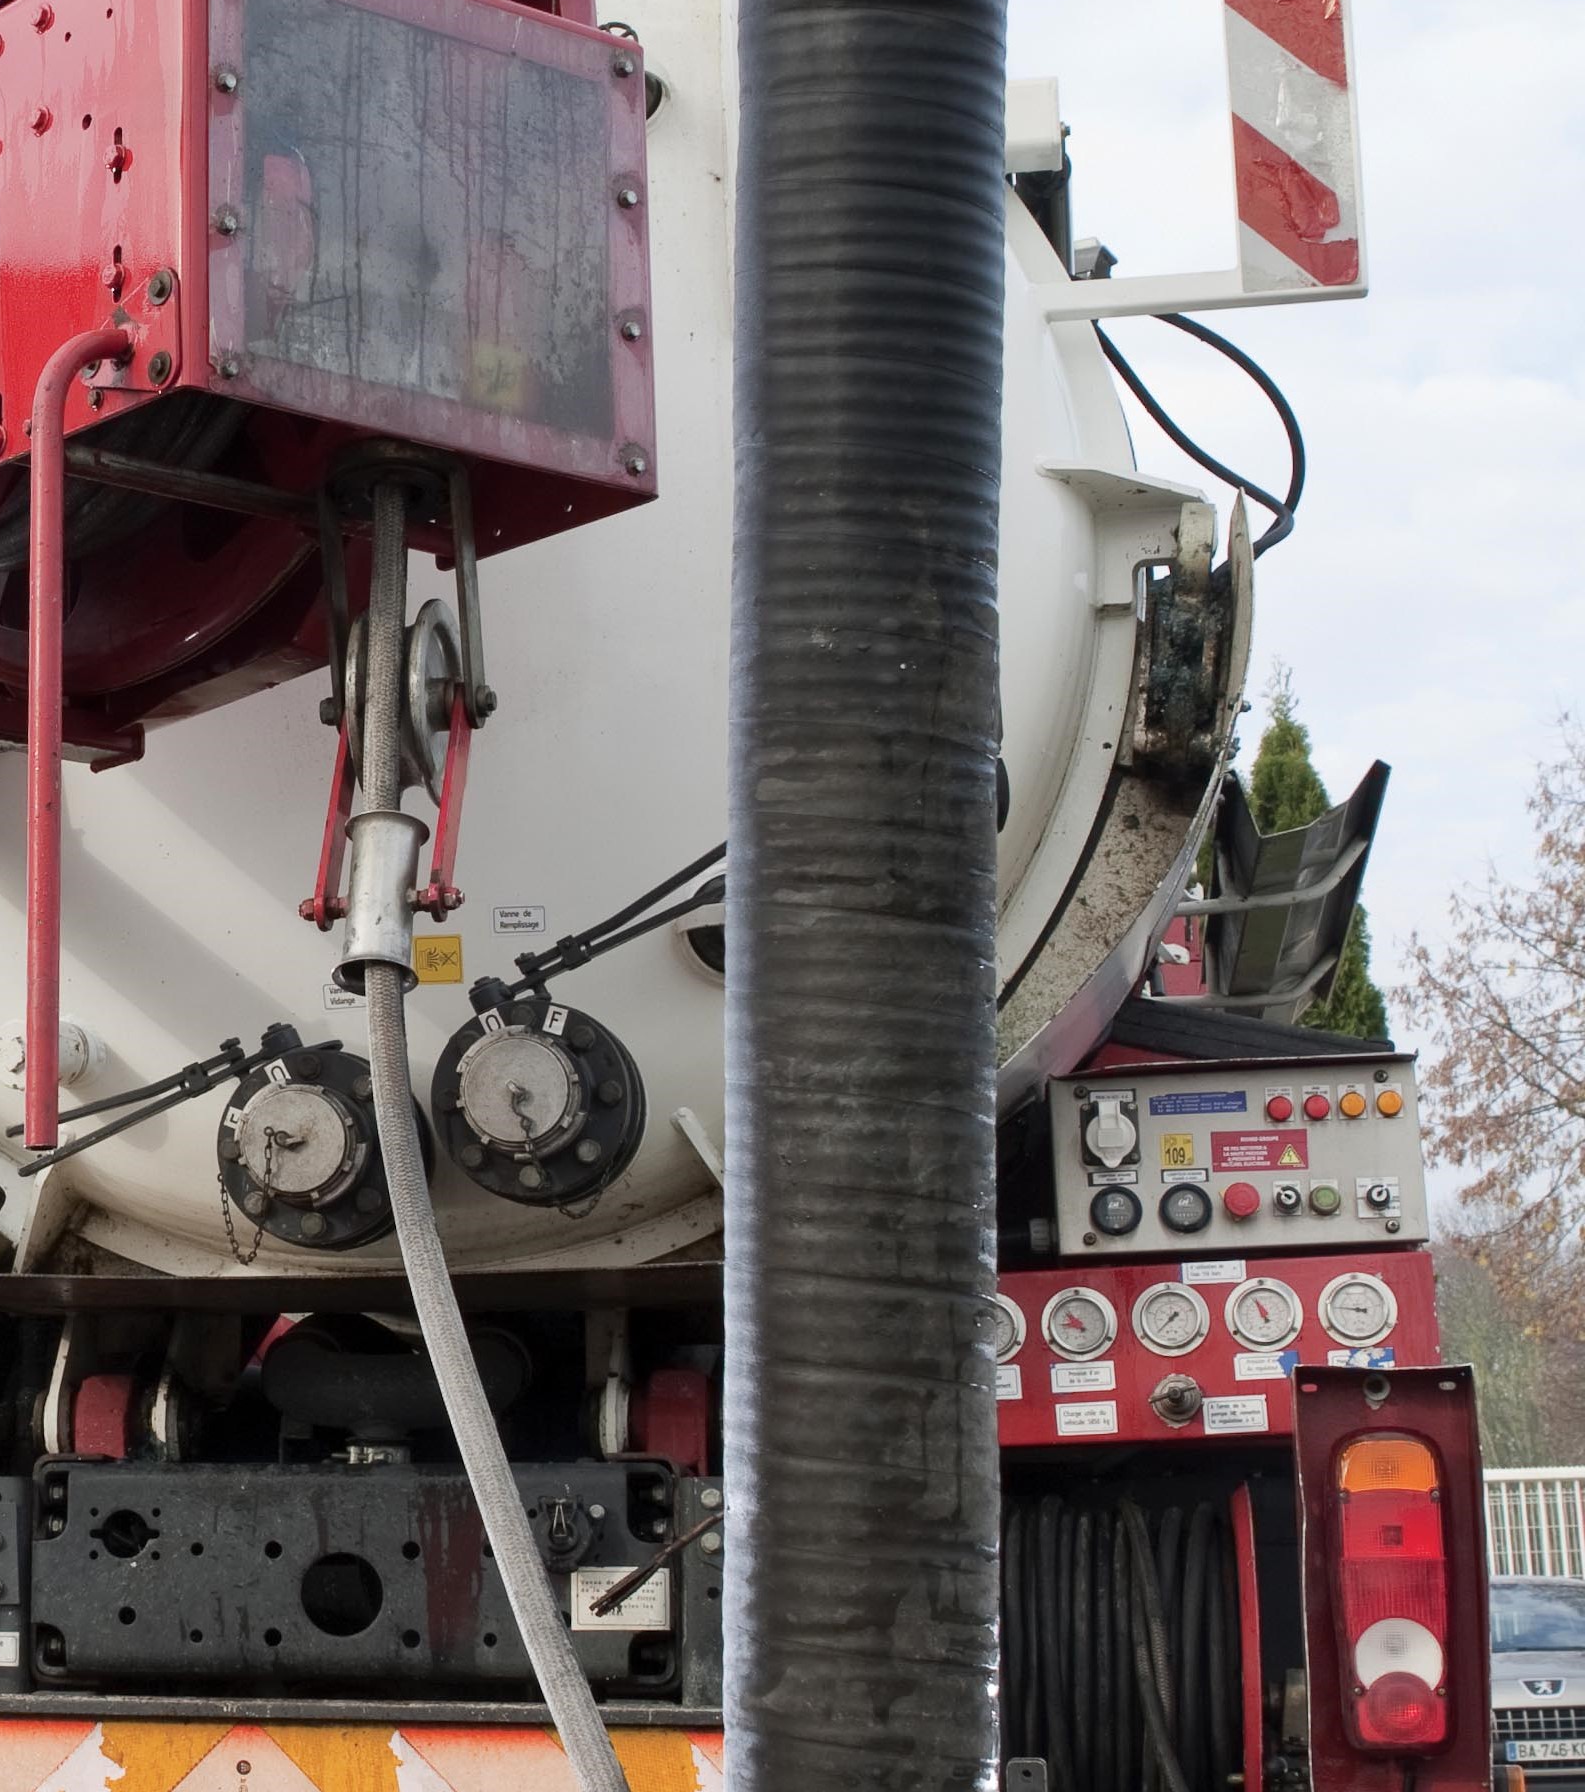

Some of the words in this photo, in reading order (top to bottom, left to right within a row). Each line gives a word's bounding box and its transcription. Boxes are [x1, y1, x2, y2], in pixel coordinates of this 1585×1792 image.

[499, 910, 519, 918] Vanne
[523, 909, 532, 918] de
[499, 919, 540, 930] Remplissage
[330, 996, 356, 1006] Vidange
[550, 1012, 563, 1028] F
[1165, 1147, 1186, 1164] 109
